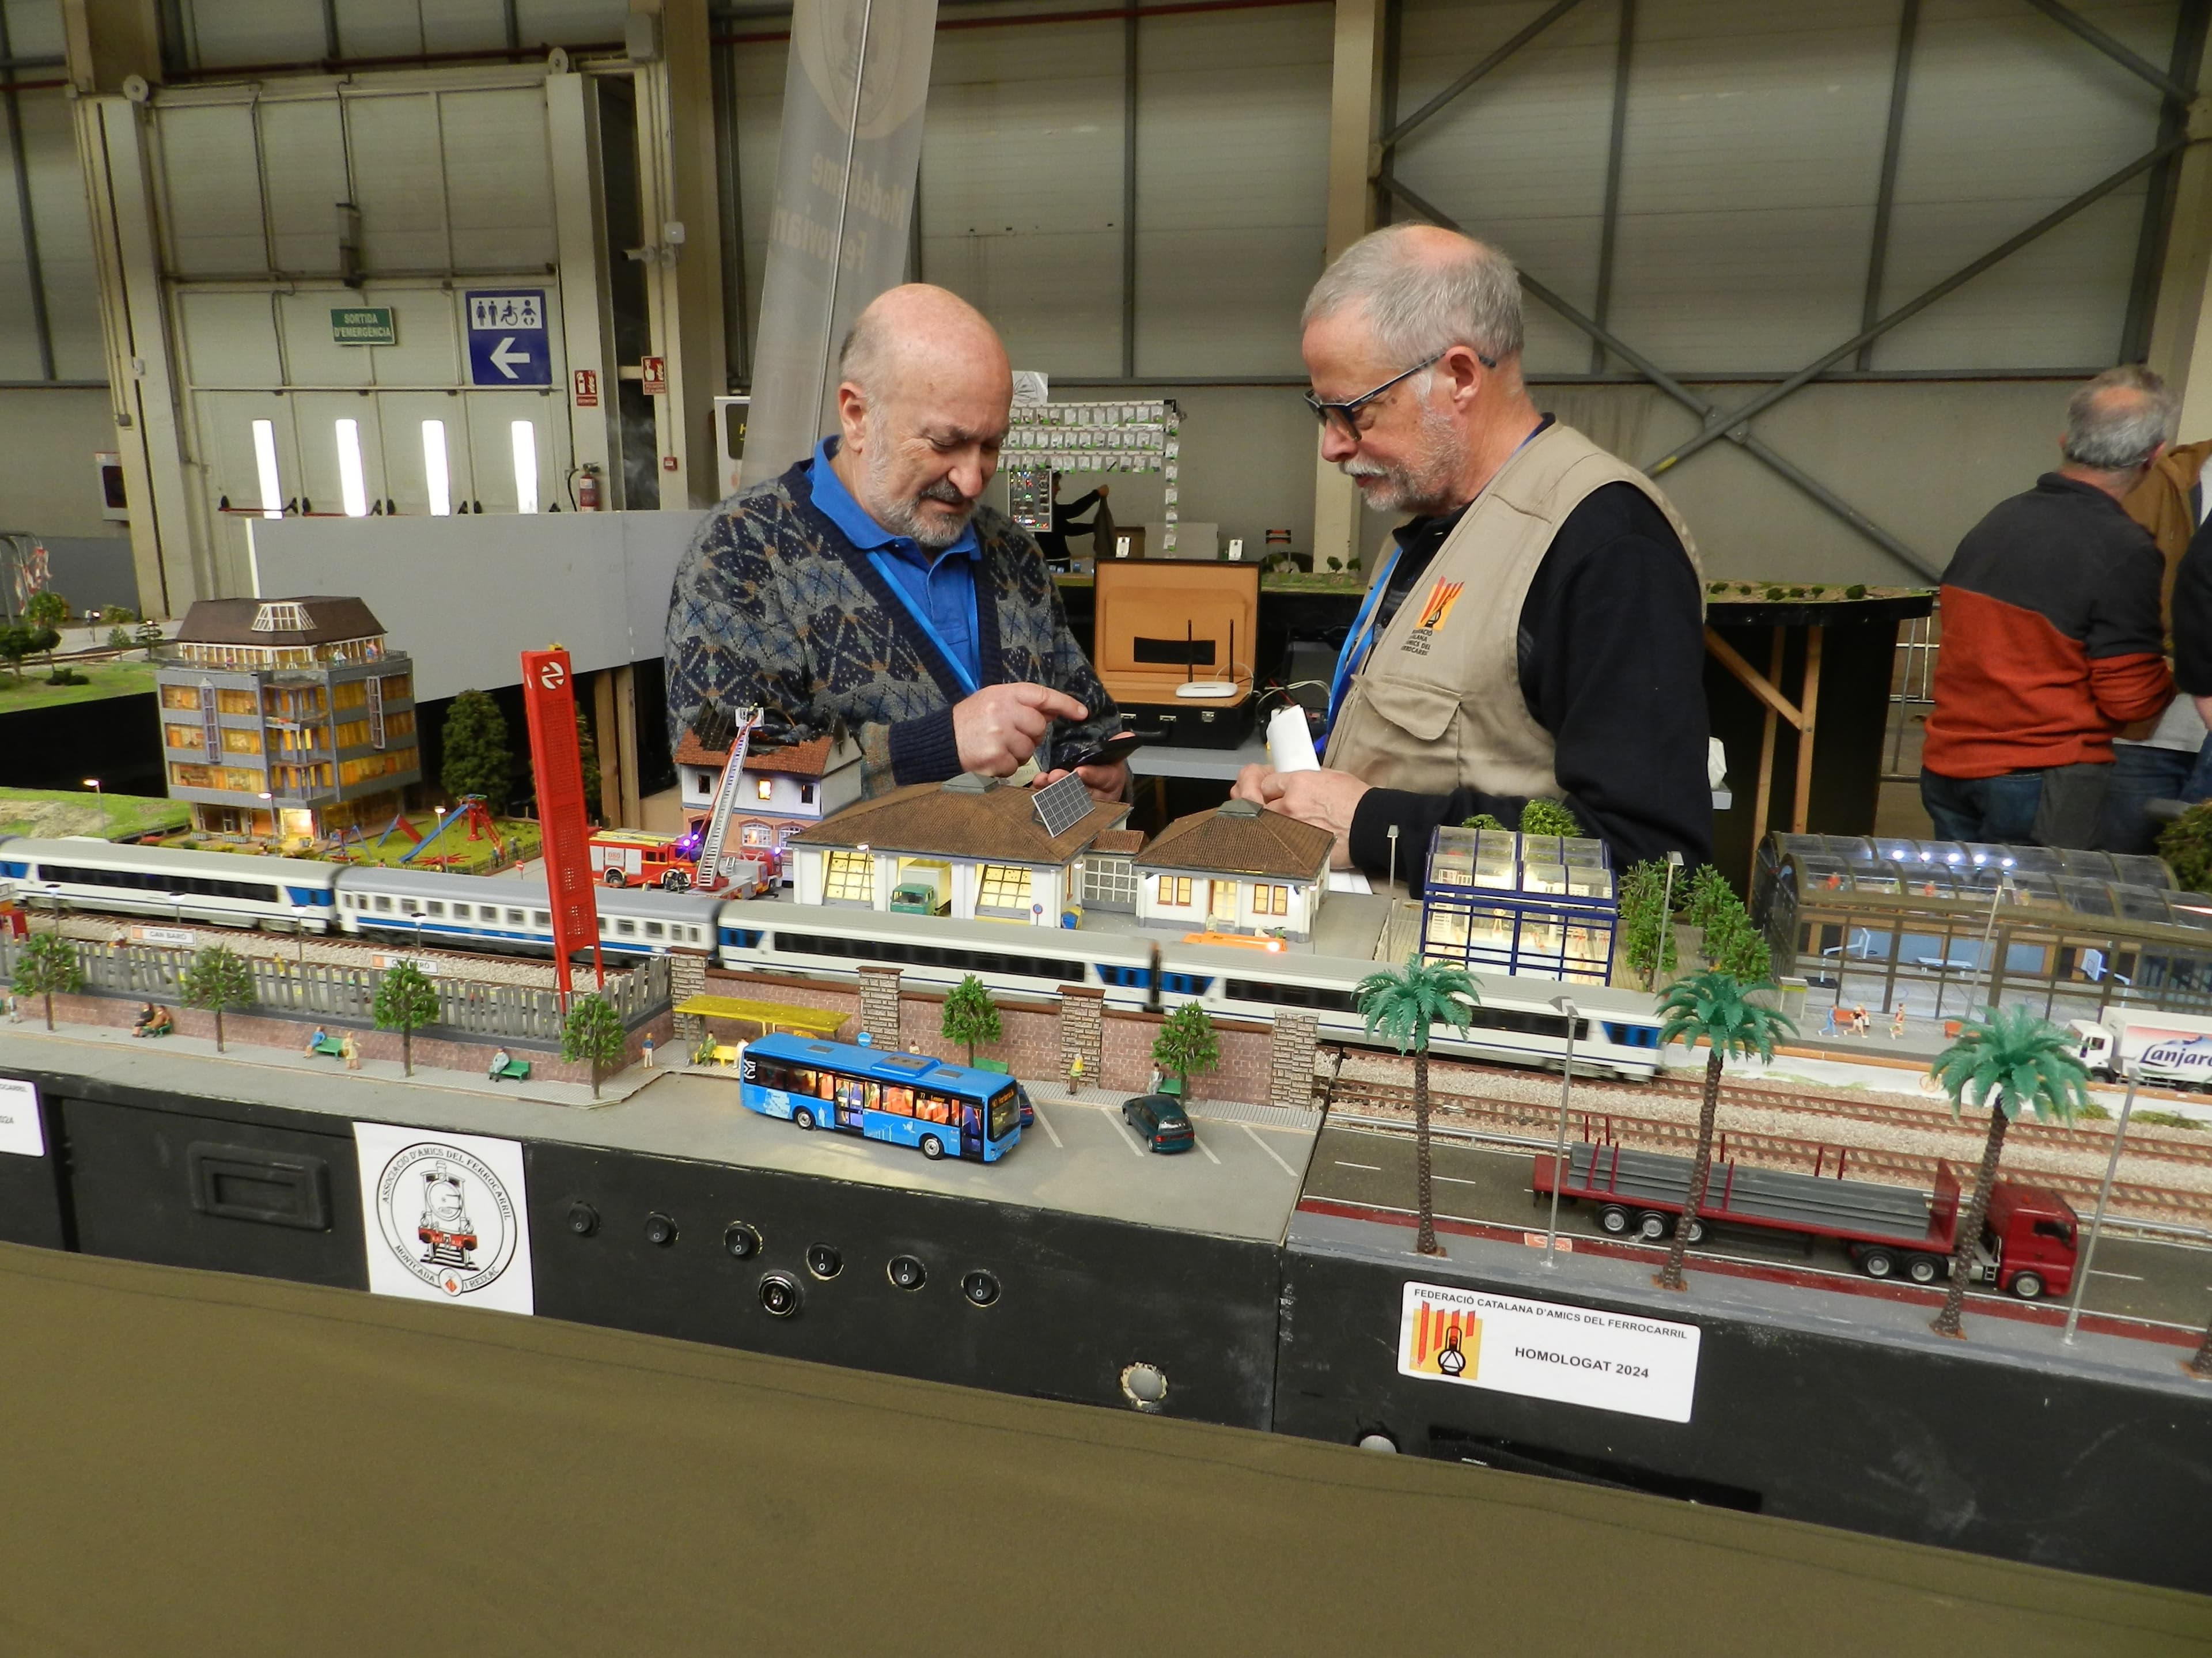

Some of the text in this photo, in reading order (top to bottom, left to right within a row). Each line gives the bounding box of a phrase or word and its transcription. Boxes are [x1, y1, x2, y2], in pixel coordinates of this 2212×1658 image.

[344, 313, 378, 324] SORTIDA
[410, 1148, 444, 1160] D'AMICS
[446, 1150, 464, 1163] DEL
[467, 1159, 511, 1220] FERROCARRIL
[395, 1245, 435, 1282] MONTCADA
[469, 1266, 499, 1288] REIXAC
[1414, 1288, 1687, 1339] FEDERACIÓ CATALANA D'AMICS DEL FERROCARRIL
[1515, 1346, 1649, 1379] HOMOLOGAT 2024
